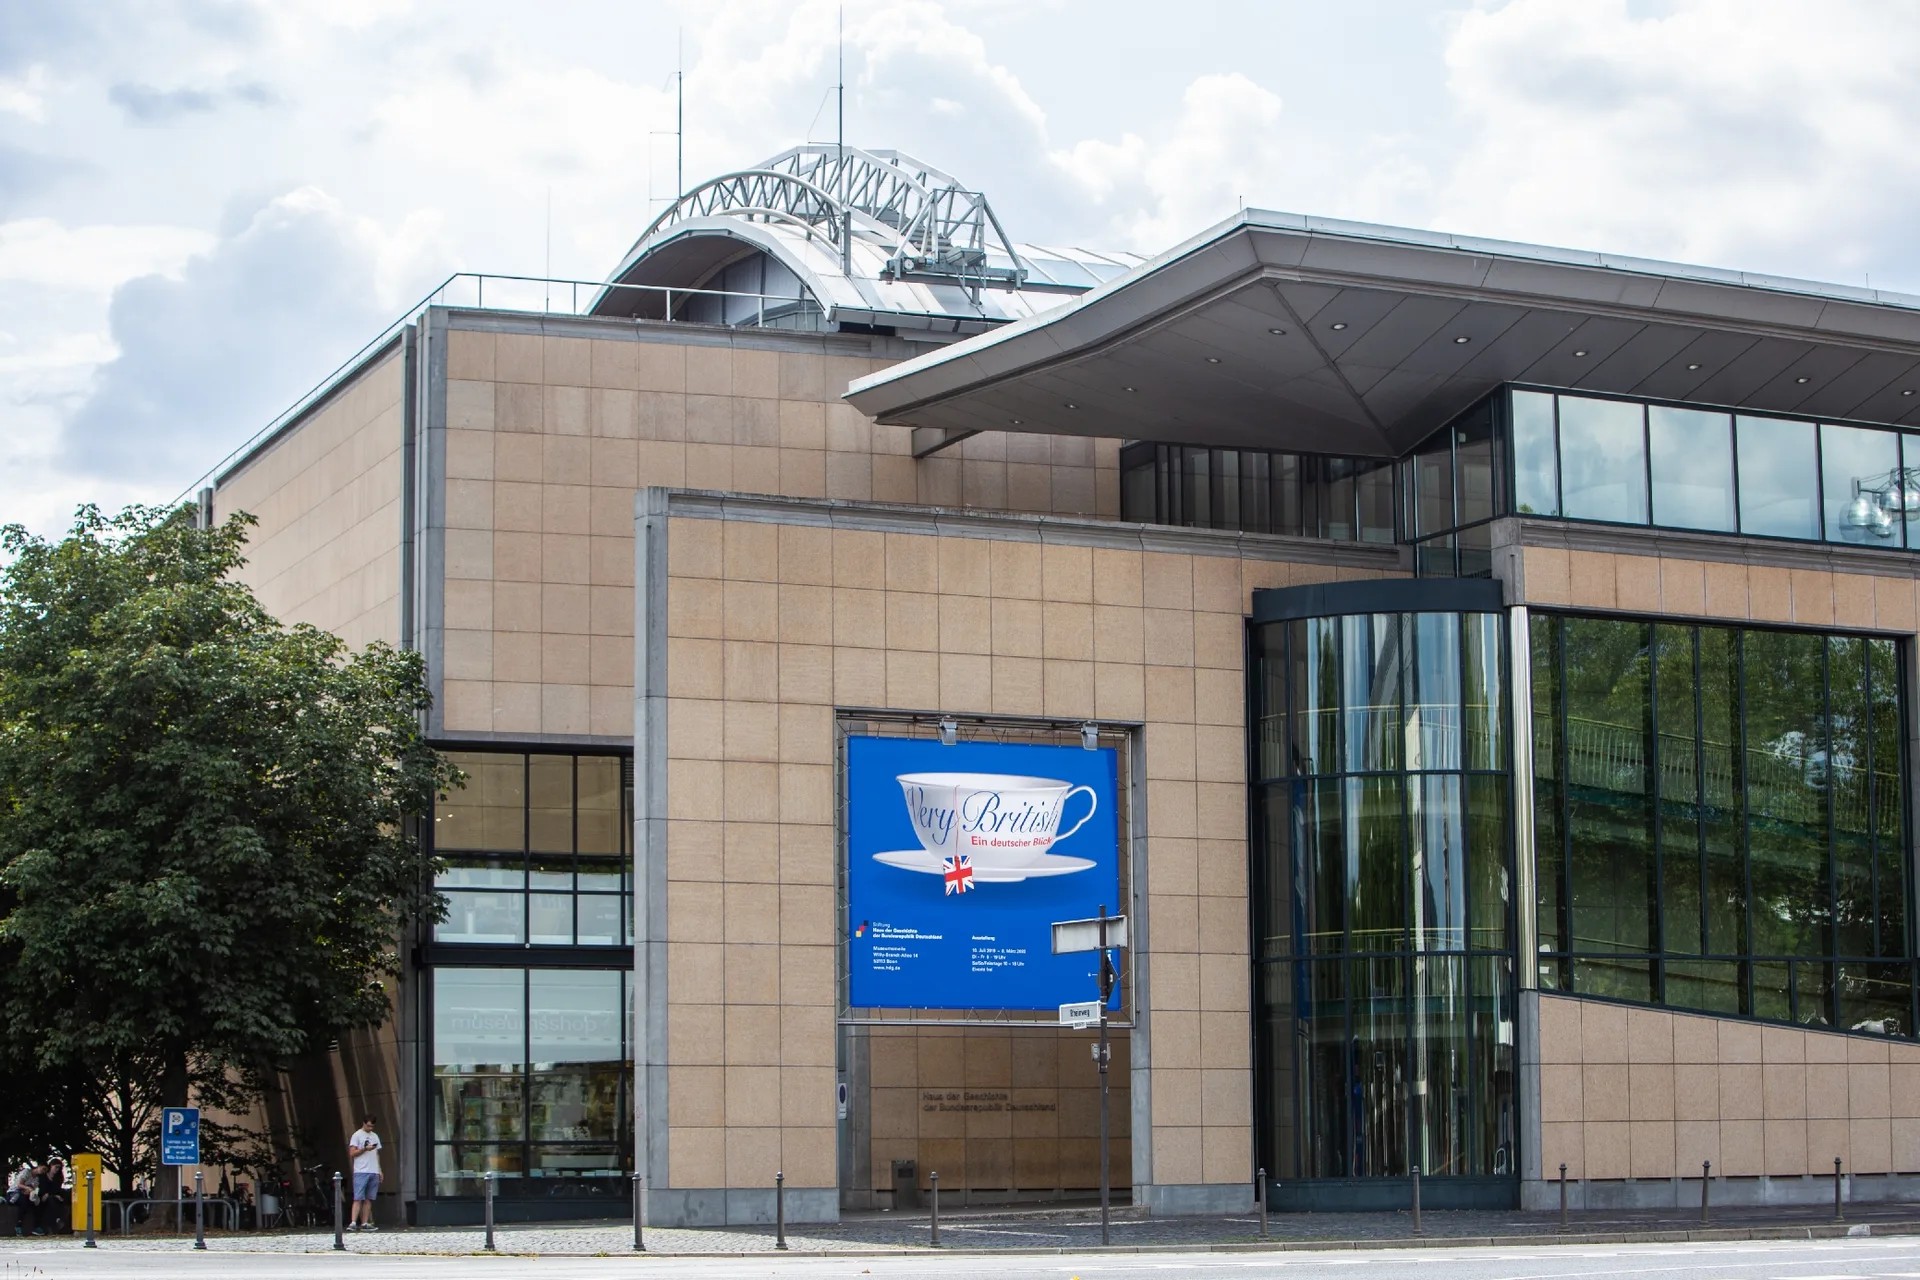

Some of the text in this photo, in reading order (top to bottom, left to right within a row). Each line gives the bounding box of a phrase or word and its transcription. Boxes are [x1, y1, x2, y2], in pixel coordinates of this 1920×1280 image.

[906, 785, 1066, 846] Very British
[971, 836, 1053, 847] Ein deutscher Blick
[872, 921, 891, 929] Stiftung
[922, 1092, 1008, 1101] Haus der Geschichte
[923, 1103, 1056, 1113] der Bundesrepublik Deutschland
[168, 1111, 184, 1134] P
